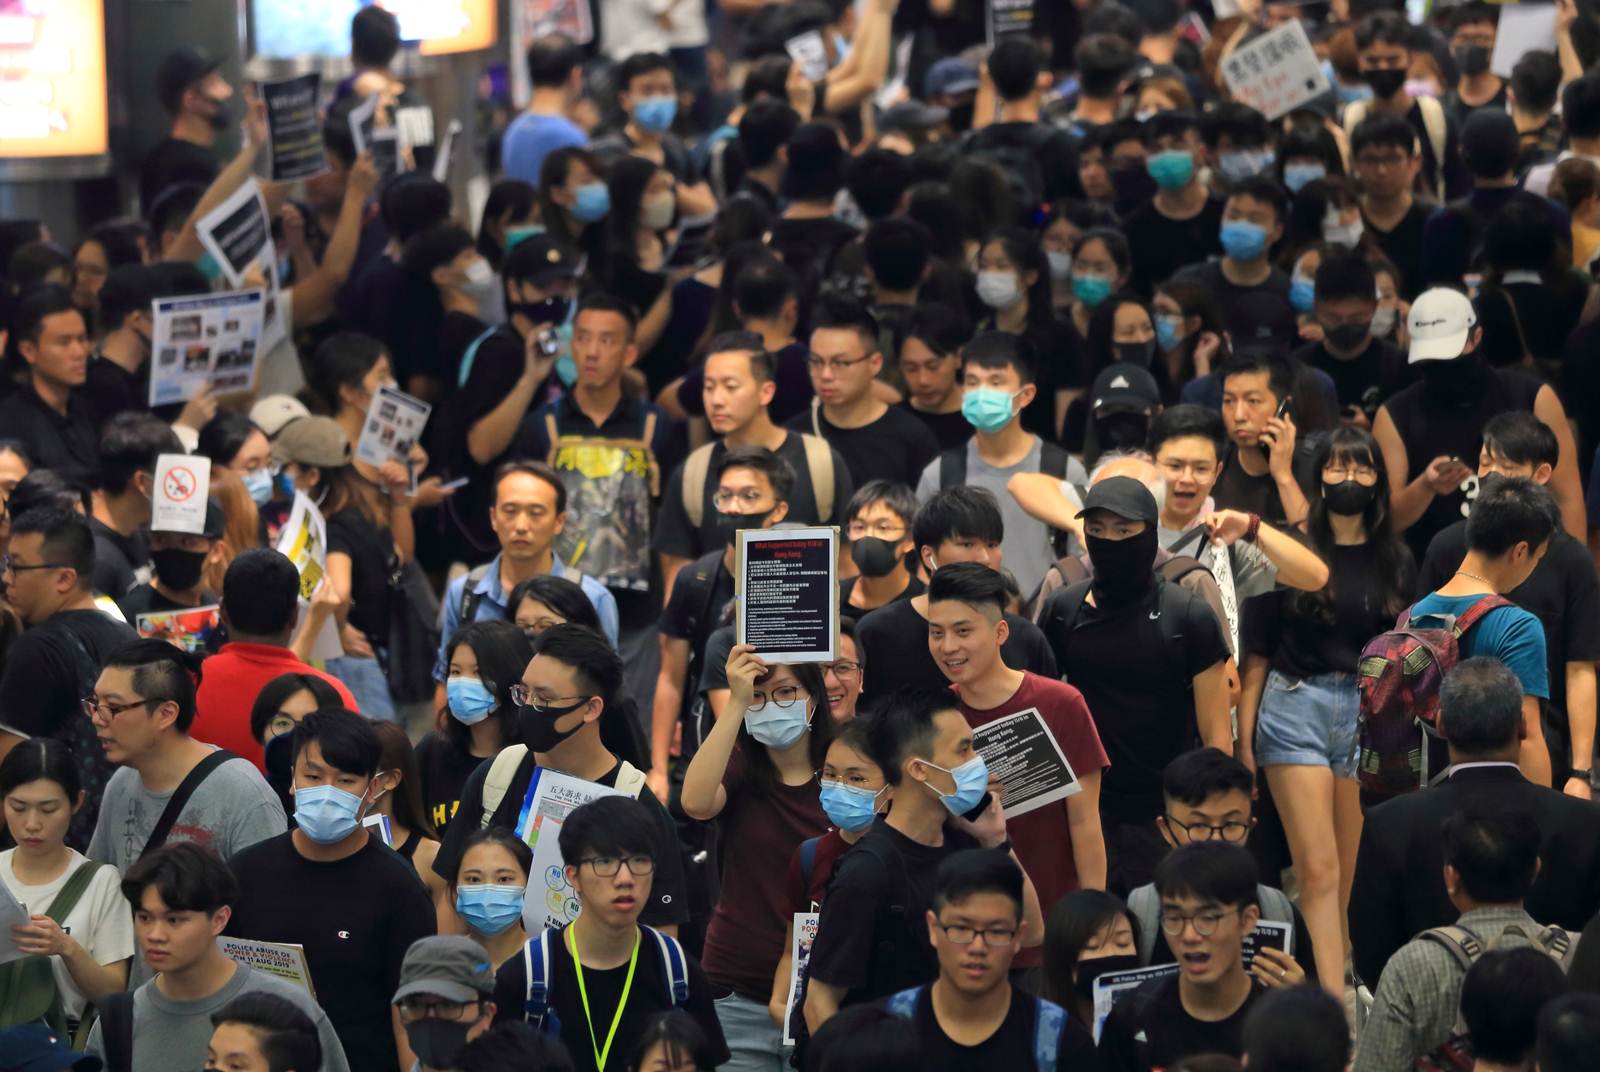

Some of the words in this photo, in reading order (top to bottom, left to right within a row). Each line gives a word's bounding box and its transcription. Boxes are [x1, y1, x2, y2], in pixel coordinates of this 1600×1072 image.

[978, 725, 1001, 739] happened
[1001, 719, 1015, 729] today
[988, 734, 1001, 742] Hong
[550, 785, 582, 801] 五大訴求
[552, 868, 561, 878] NO
[570, 902, 580, 912] NO
[227, 943, 253, 952] POLICE
[256, 947, 278, 956] ABUSE
[224, 948, 250, 957] POWER
[260, 953, 296, 964] VIOLENCE
[274, 960, 290, 968] 2019
